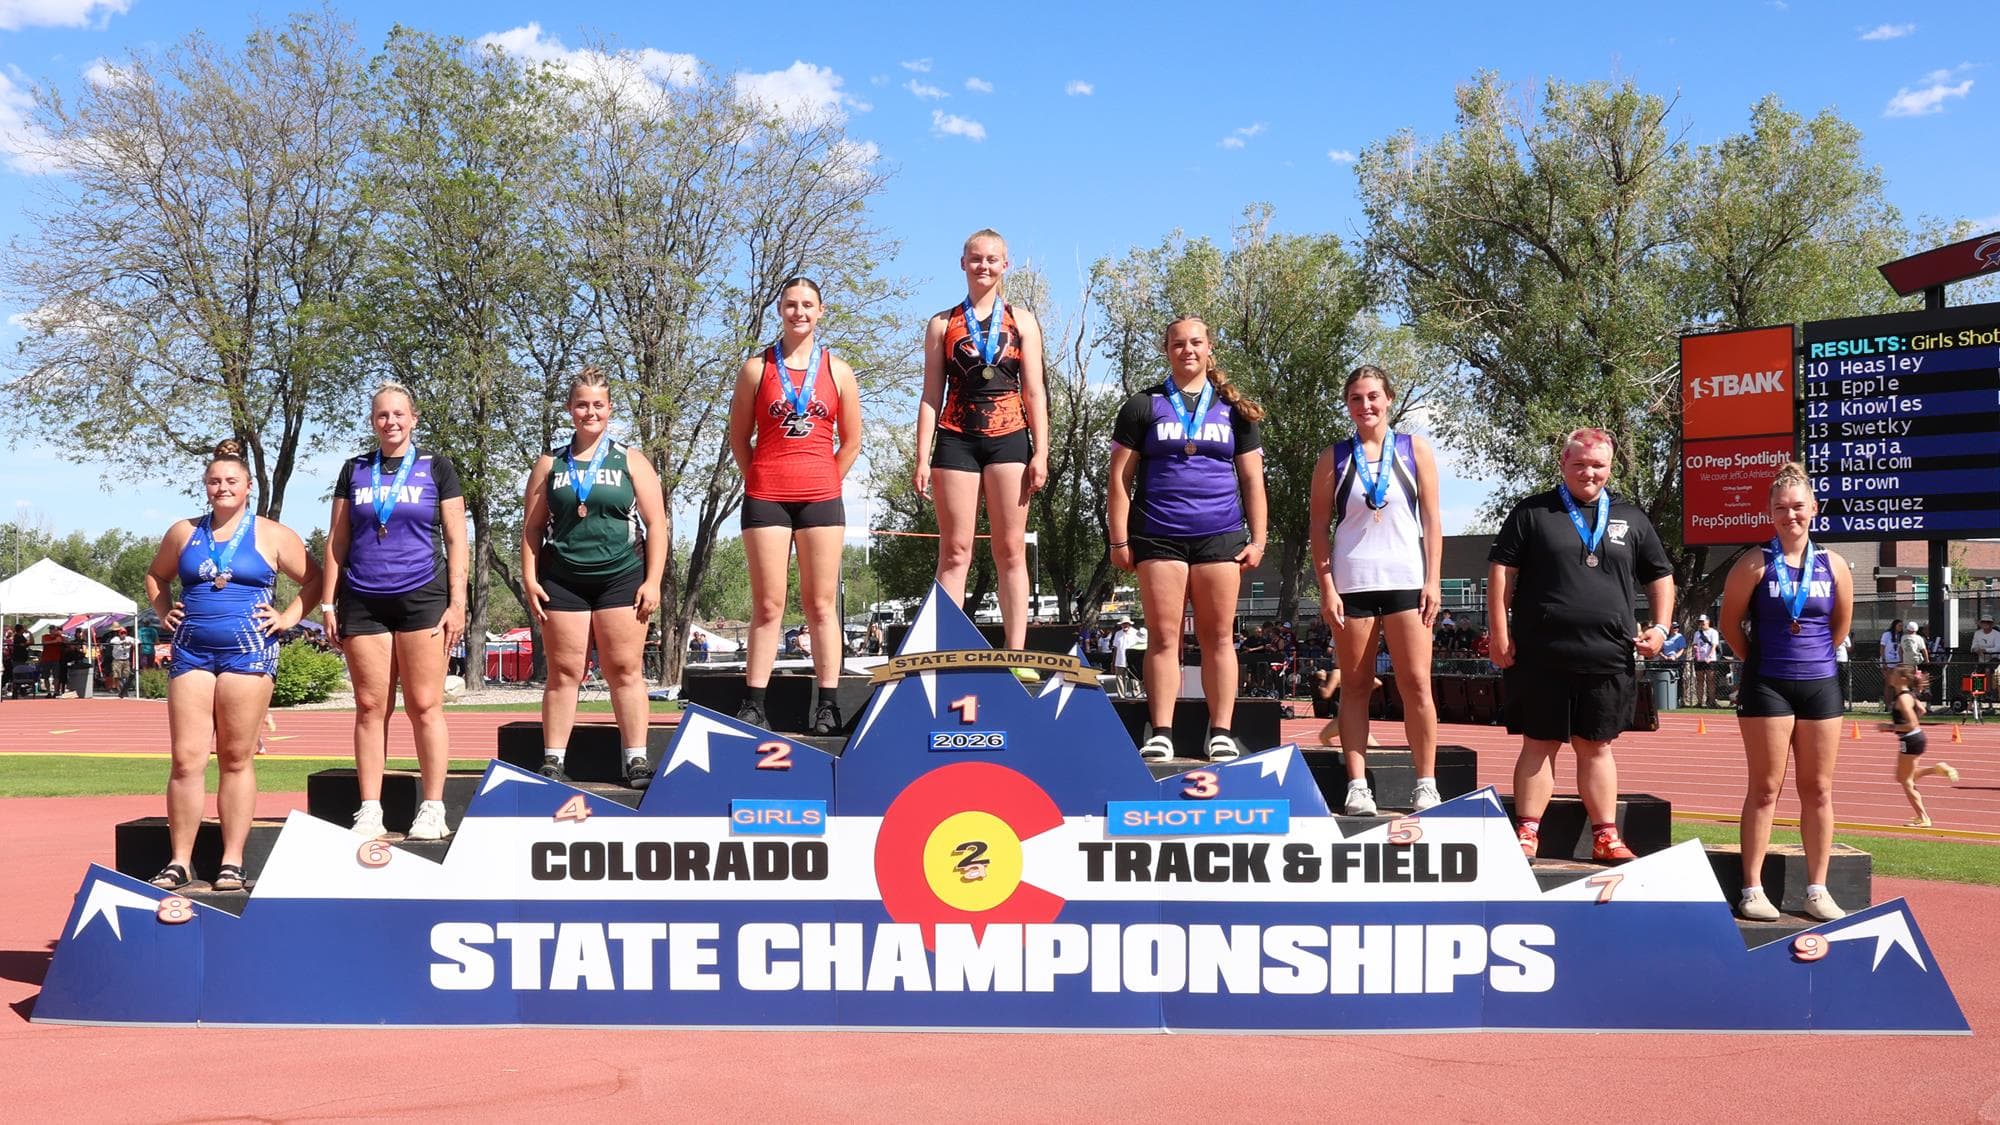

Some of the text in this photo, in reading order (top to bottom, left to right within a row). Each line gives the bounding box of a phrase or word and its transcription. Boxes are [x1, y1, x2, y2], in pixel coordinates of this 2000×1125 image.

[1811, 328, 2000, 358] RESULTS: Girls Shot
[1807, 355, 1924, 378] 10 Heasley
[1807, 376, 1900, 397] 11 Epple
[1808, 396, 1922, 418] 12 Knowles
[1808, 417, 1912, 438] 13 Swetky
[1686, 450, 1791, 470] CO Prep Spotlight
[1809, 439, 1902, 458] 14 Tapia
[1808, 454, 1912, 473] 15 Malcom
[1809, 476, 1899, 492] 16 Brown
[1842, 498, 1924, 514] Vasquez
[1809, 516, 1924, 532] 18 Vasquez
[895, 652, 1073, 668] STATE CHAMPION
[951, 696, 977, 723] 1
[933, 733, 1004, 749] 2026
[757, 742, 793, 769] 2
[1184, 771, 1220, 799] 3
[554, 795, 592, 821] 4
[733, 809, 821, 825] GIRLS
[1123, 808, 1275, 826] SHOT PUT
[1388, 817, 1423, 844] 5
[358, 839, 393, 868] 6
[531, 841, 829, 881] COLORADO
[1078, 842, 1478, 883] TRACK & FIELD
[1590, 873, 1624, 904] 7
[157, 895, 193, 924] 8
[430, 922, 1556, 994] STATE CHAMPIONSHIPS
[1793, 932, 1829, 962] 9
